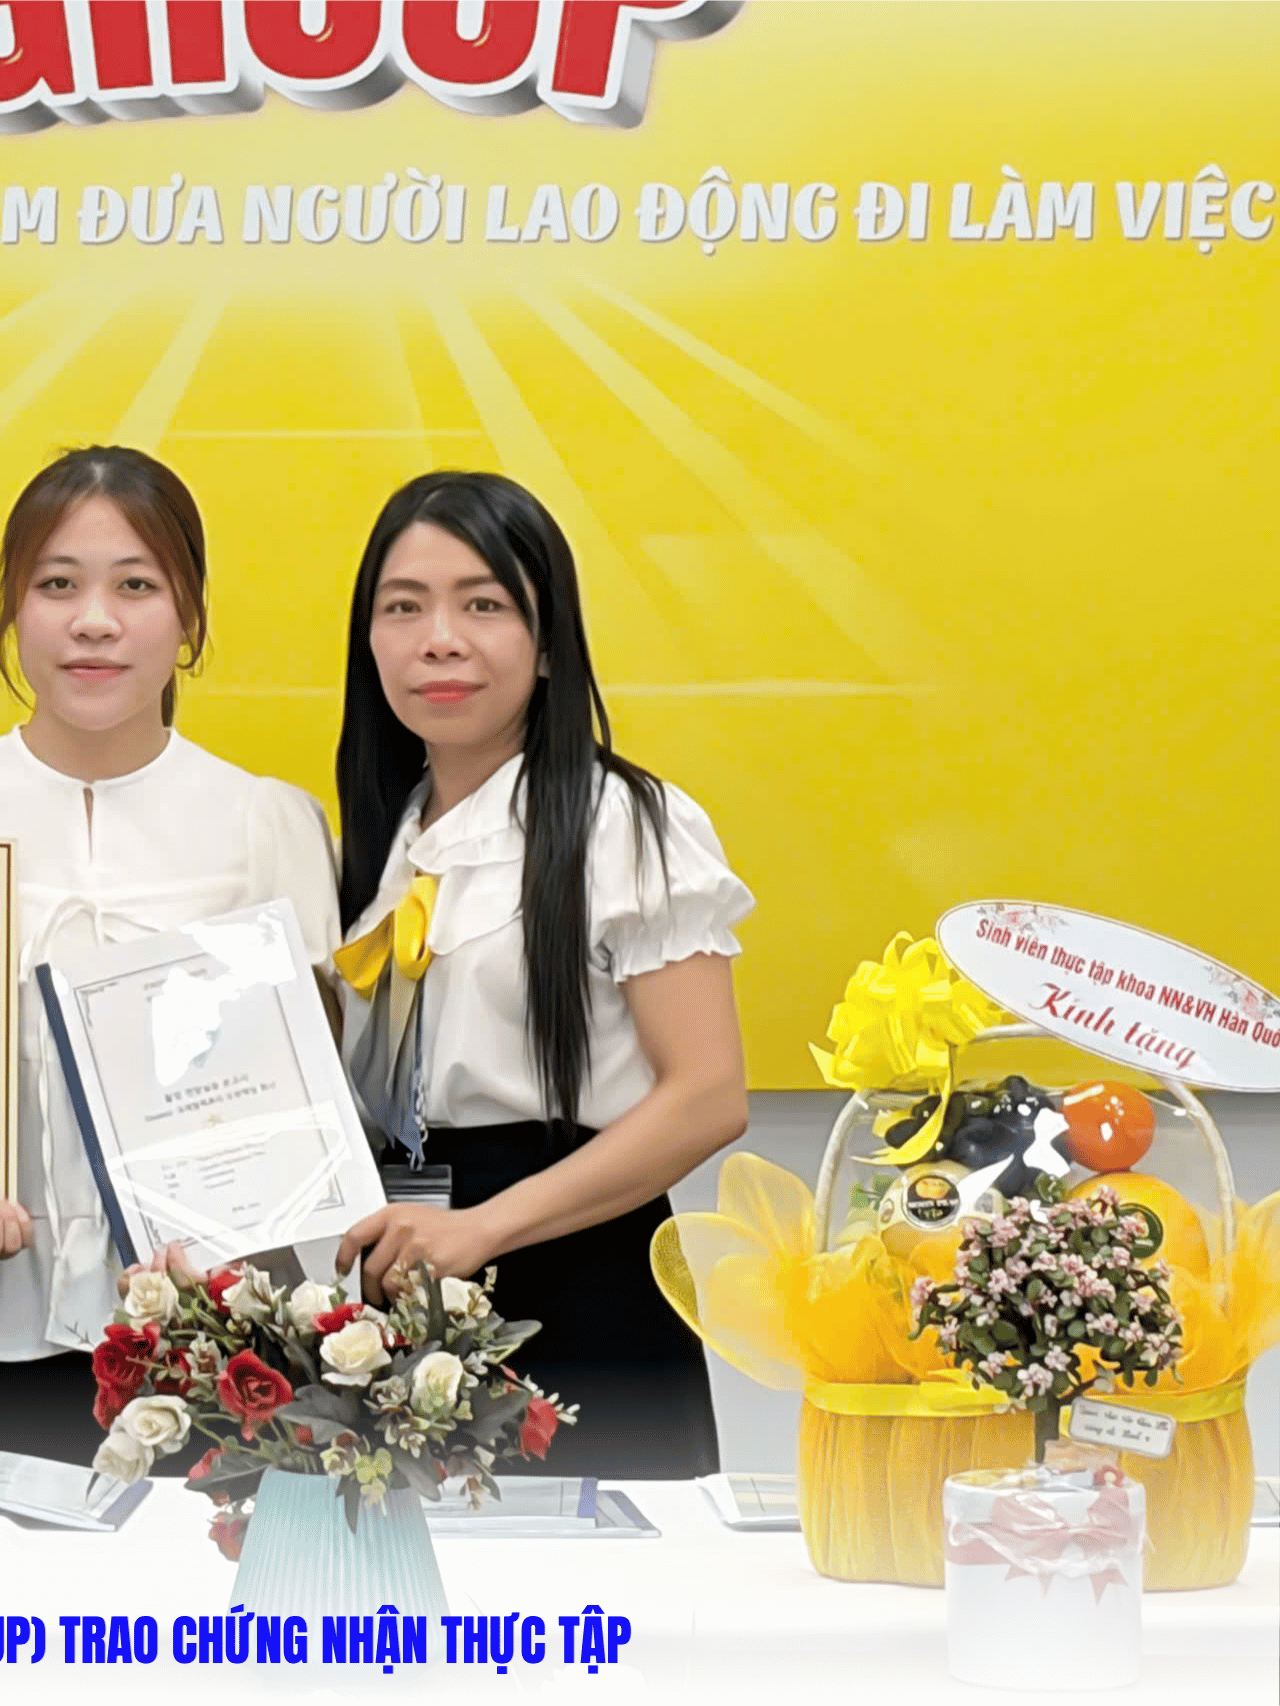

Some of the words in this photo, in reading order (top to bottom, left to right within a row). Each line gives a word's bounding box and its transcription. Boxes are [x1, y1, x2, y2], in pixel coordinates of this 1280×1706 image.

[77, 172, 224, 244] ĐƯA
[243, 167, 466, 244] NGƯỜI
[486, 183, 620, 243] LAO
[634, 166, 838, 254] ĐỘNG
[854, 181, 930, 241] ĐI
[950, 164, 1096, 241] LÀM
[1116, 163, 1276, 253] VIỆC
[976, 918, 1012, 948] Sinh
[1014, 935, 1049, 961] viên
[1050, 947, 1085, 976] thực
[1088, 959, 1114, 987] tập
[1116, 969, 1156, 1002] khoa
[1158, 986, 1218, 1024] NN&VH
[1218, 1007, 1249, 1037] Hàn
[1028, 982, 1116, 1038] Kính
